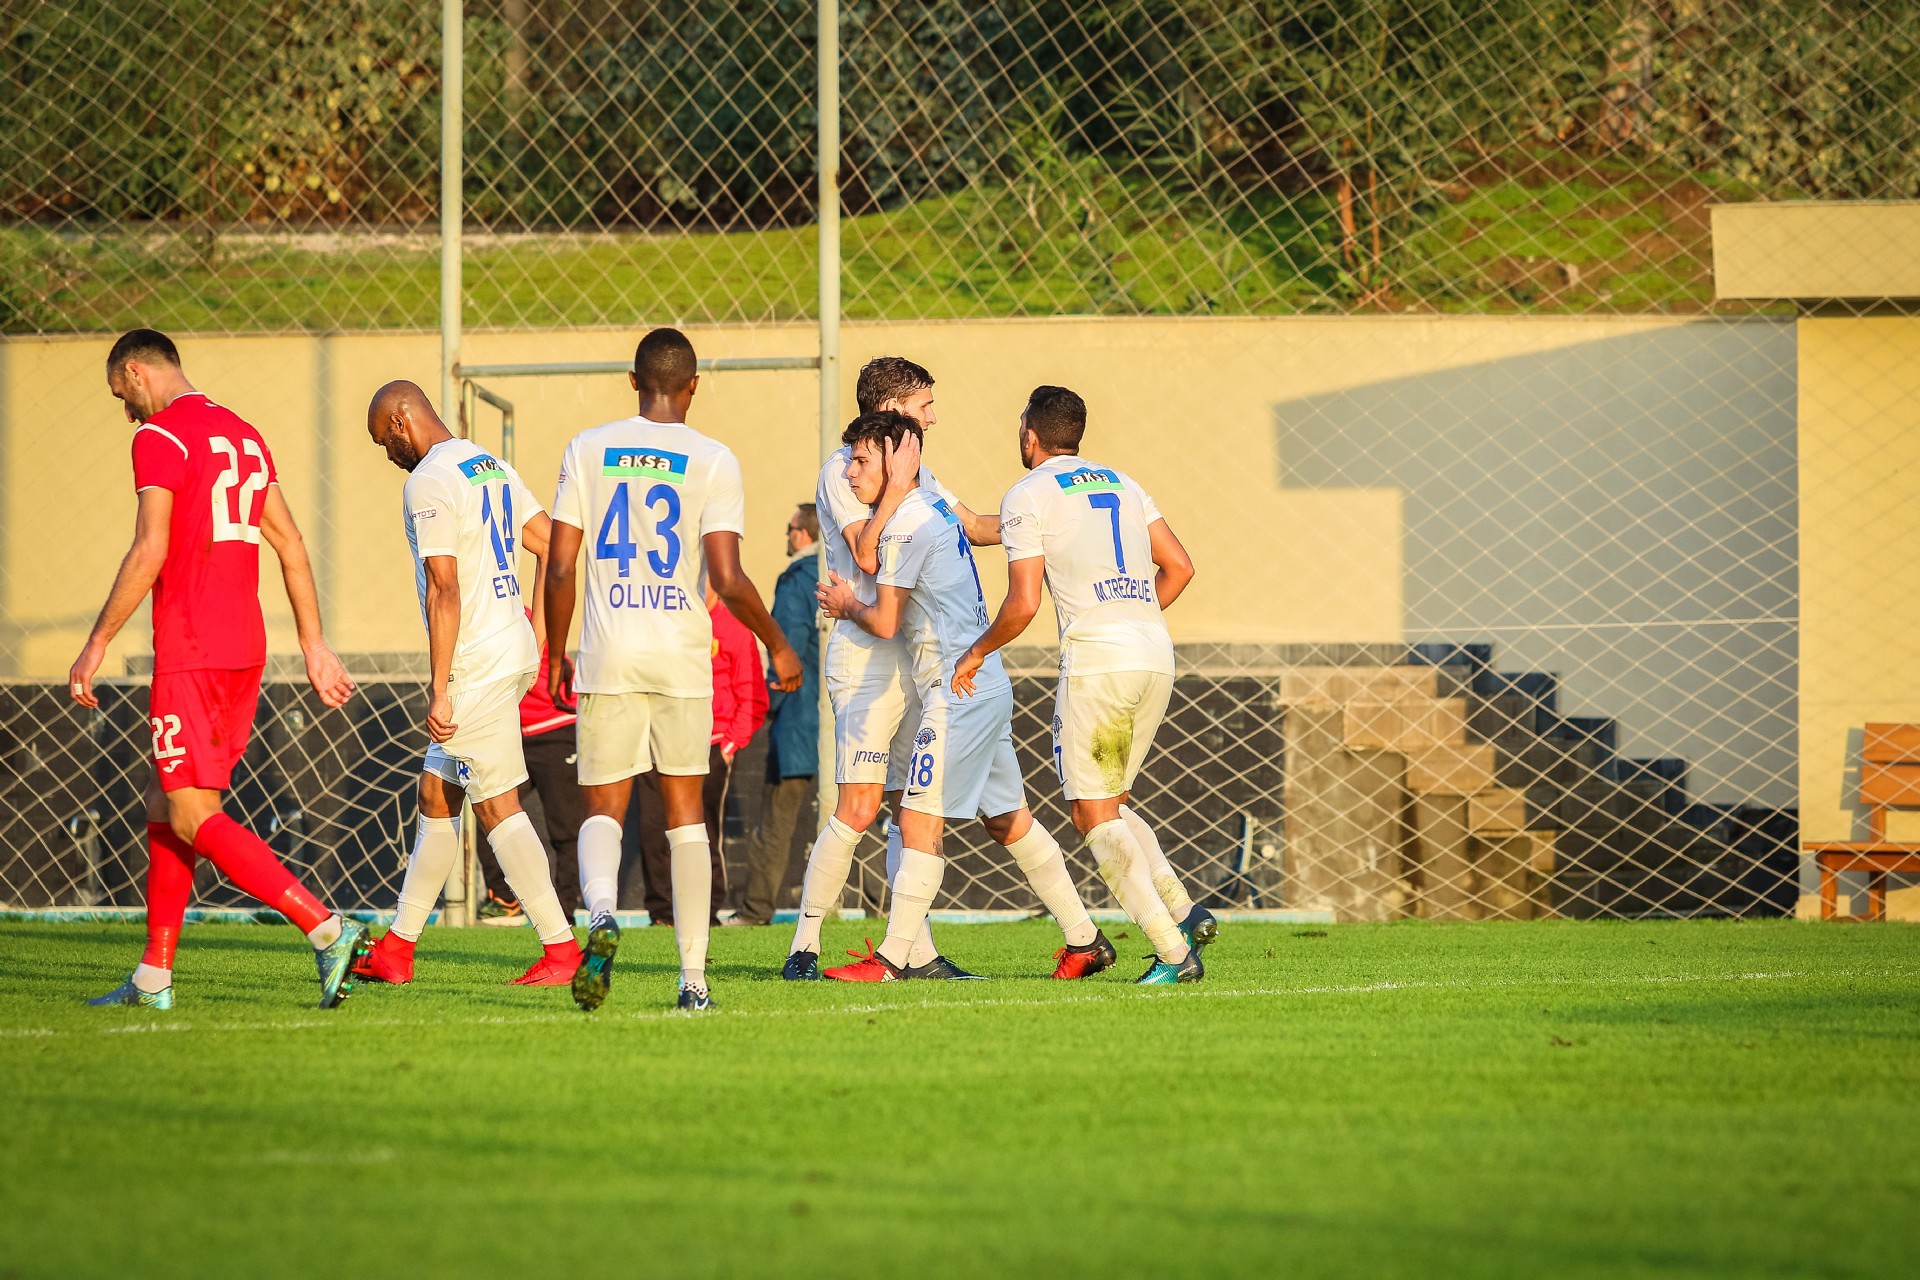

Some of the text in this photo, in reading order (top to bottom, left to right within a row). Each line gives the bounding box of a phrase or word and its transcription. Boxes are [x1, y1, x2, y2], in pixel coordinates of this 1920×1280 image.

[618, 454, 672, 471] aksa
[1071, 472, 1110, 485] aksa
[209, 436, 269, 544] 22
[482, 483, 515, 570] 14
[597, 482, 681, 578] 43
[1088, 493, 1126, 574] 7
[609, 583, 691, 611] OLIVER
[152, 714, 186, 759] 22
[910, 753, 934, 787] 18
